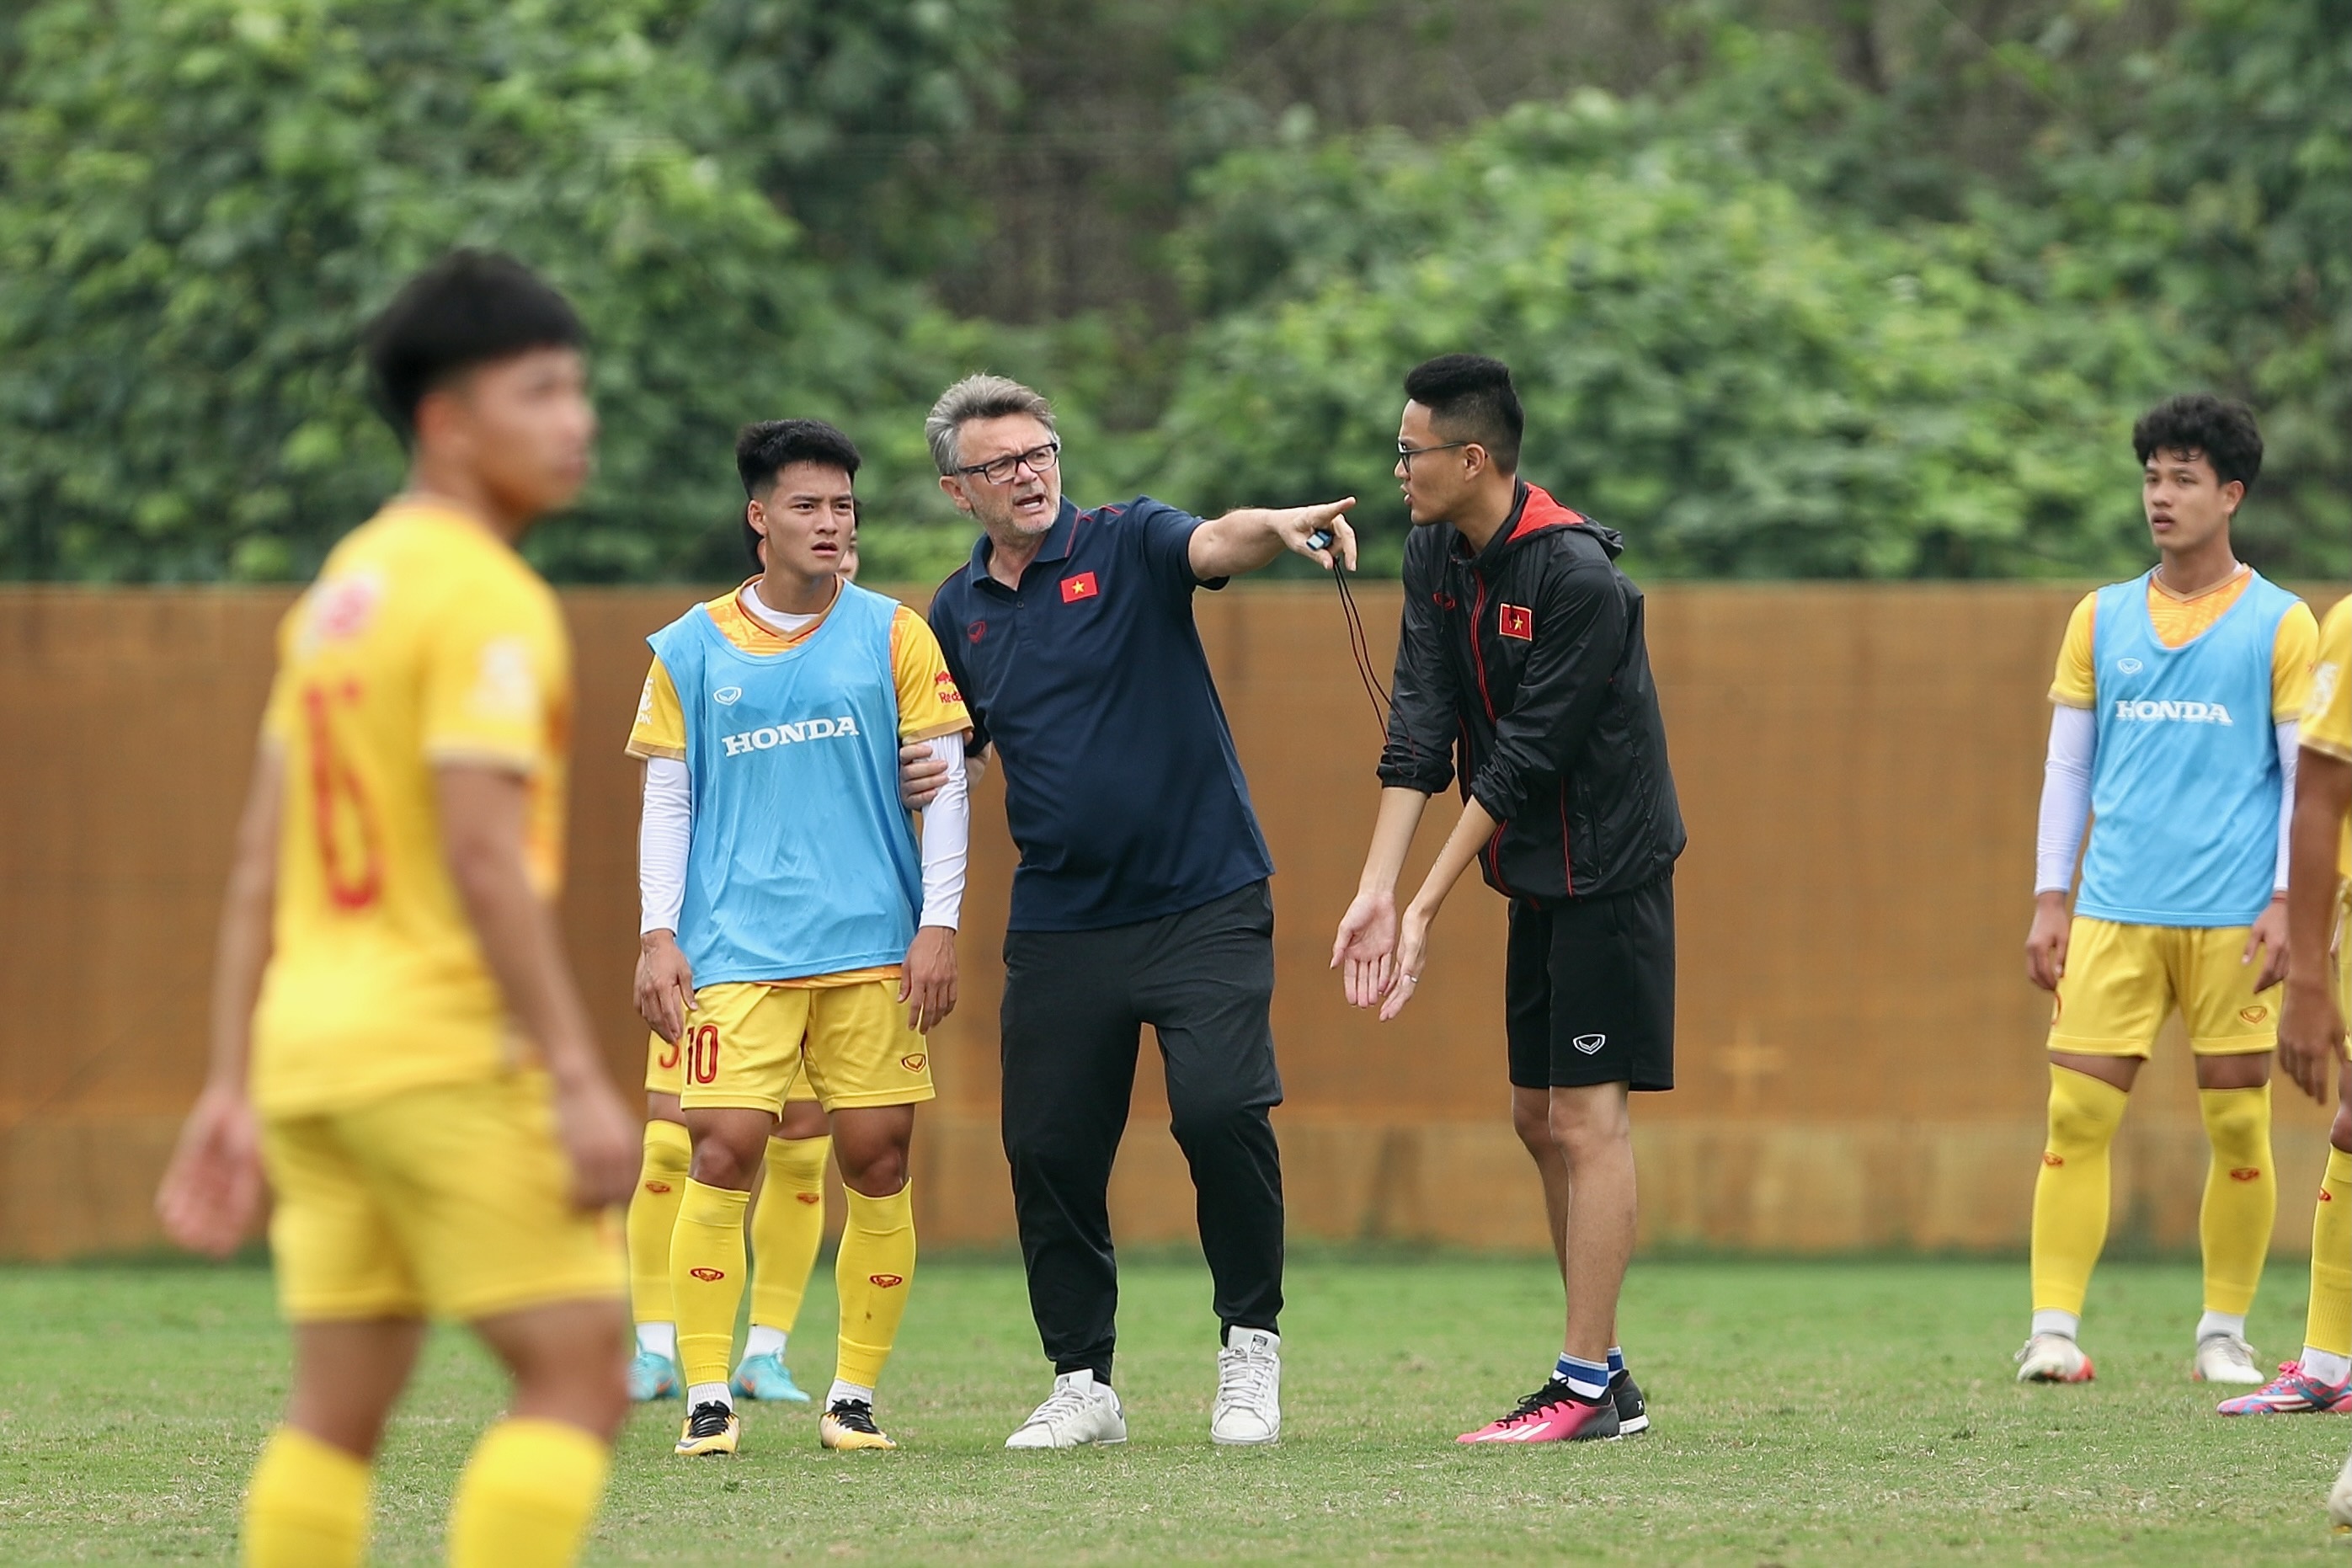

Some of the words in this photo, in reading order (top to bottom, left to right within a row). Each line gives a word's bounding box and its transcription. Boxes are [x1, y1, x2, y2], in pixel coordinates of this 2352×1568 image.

[2115, 700, 2232, 727] HONDA
[722, 716, 860, 757] HONDA
[686, 1024, 718, 1085] 10
